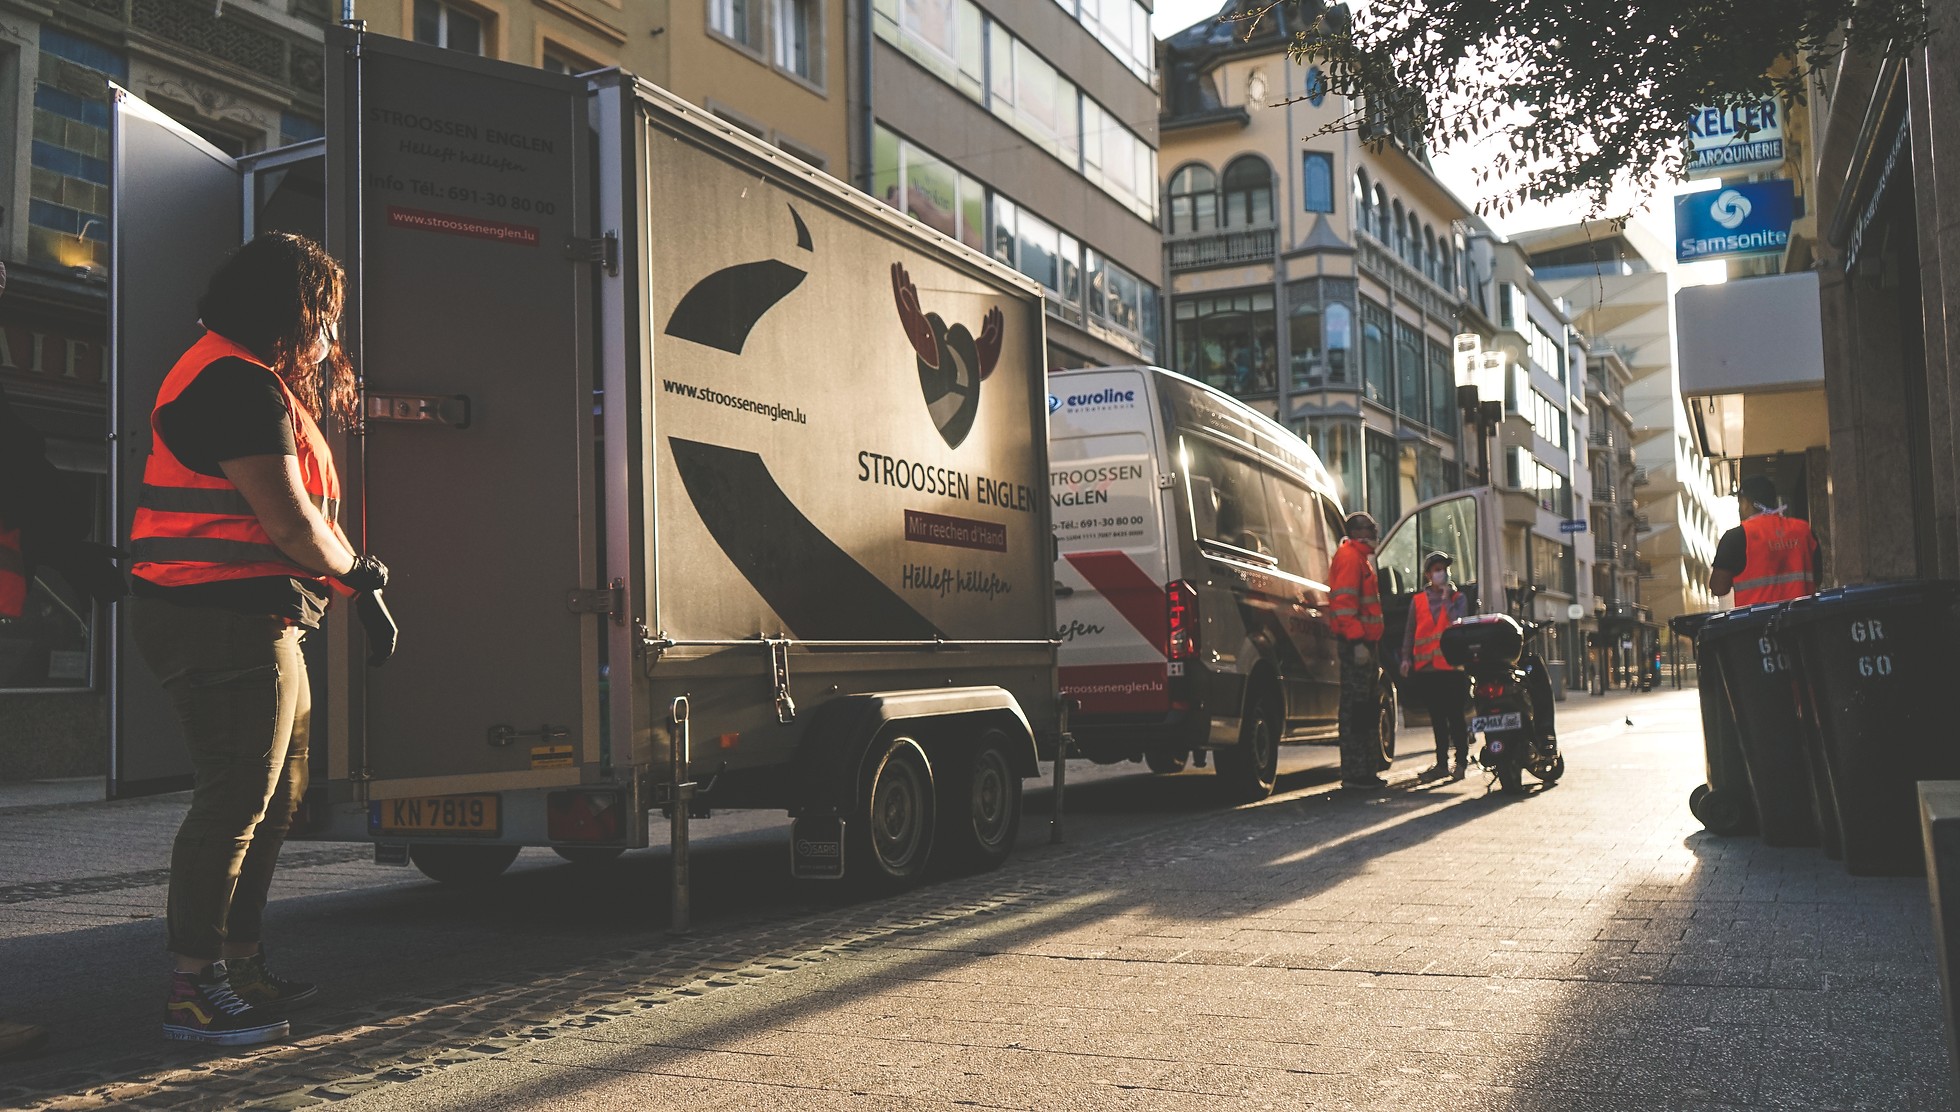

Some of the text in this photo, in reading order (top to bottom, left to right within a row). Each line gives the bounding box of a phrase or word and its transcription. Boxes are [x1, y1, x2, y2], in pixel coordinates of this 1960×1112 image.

[369, 107, 554, 154] STROOSSEN ENGLEN
[368, 173, 556, 216] Info Tél.: 691-30 80 00
[393, 211, 535, 242] www.stroossenenglen.lu
[1681, 229, 1788, 257] Samsonite
[663, 378, 807, 425] www.stroossenenglen.lu
[1067, 388, 1135, 406] euroline
[858, 450, 1037, 513] STROOSSEN ENGLEN
[1050, 465, 1142, 486] TROOSSEN
[1050, 489, 1108, 507] NGLEN
[909, 515, 926, 536] Mir
[929, 521, 969, 542] reechen
[1130, 515, 1144, 525] 00
[902, 563, 1012, 601] Hëlleft hëllefen
[1058, 619, 1105, 642] efen
[1858, 653, 1893, 678] 60
[1060, 681, 1163, 694] stroossenenglen.lu
[393, 799, 422, 827] KN
[427, 799, 484, 827] 7819
[811, 844, 837, 855] SARIS
